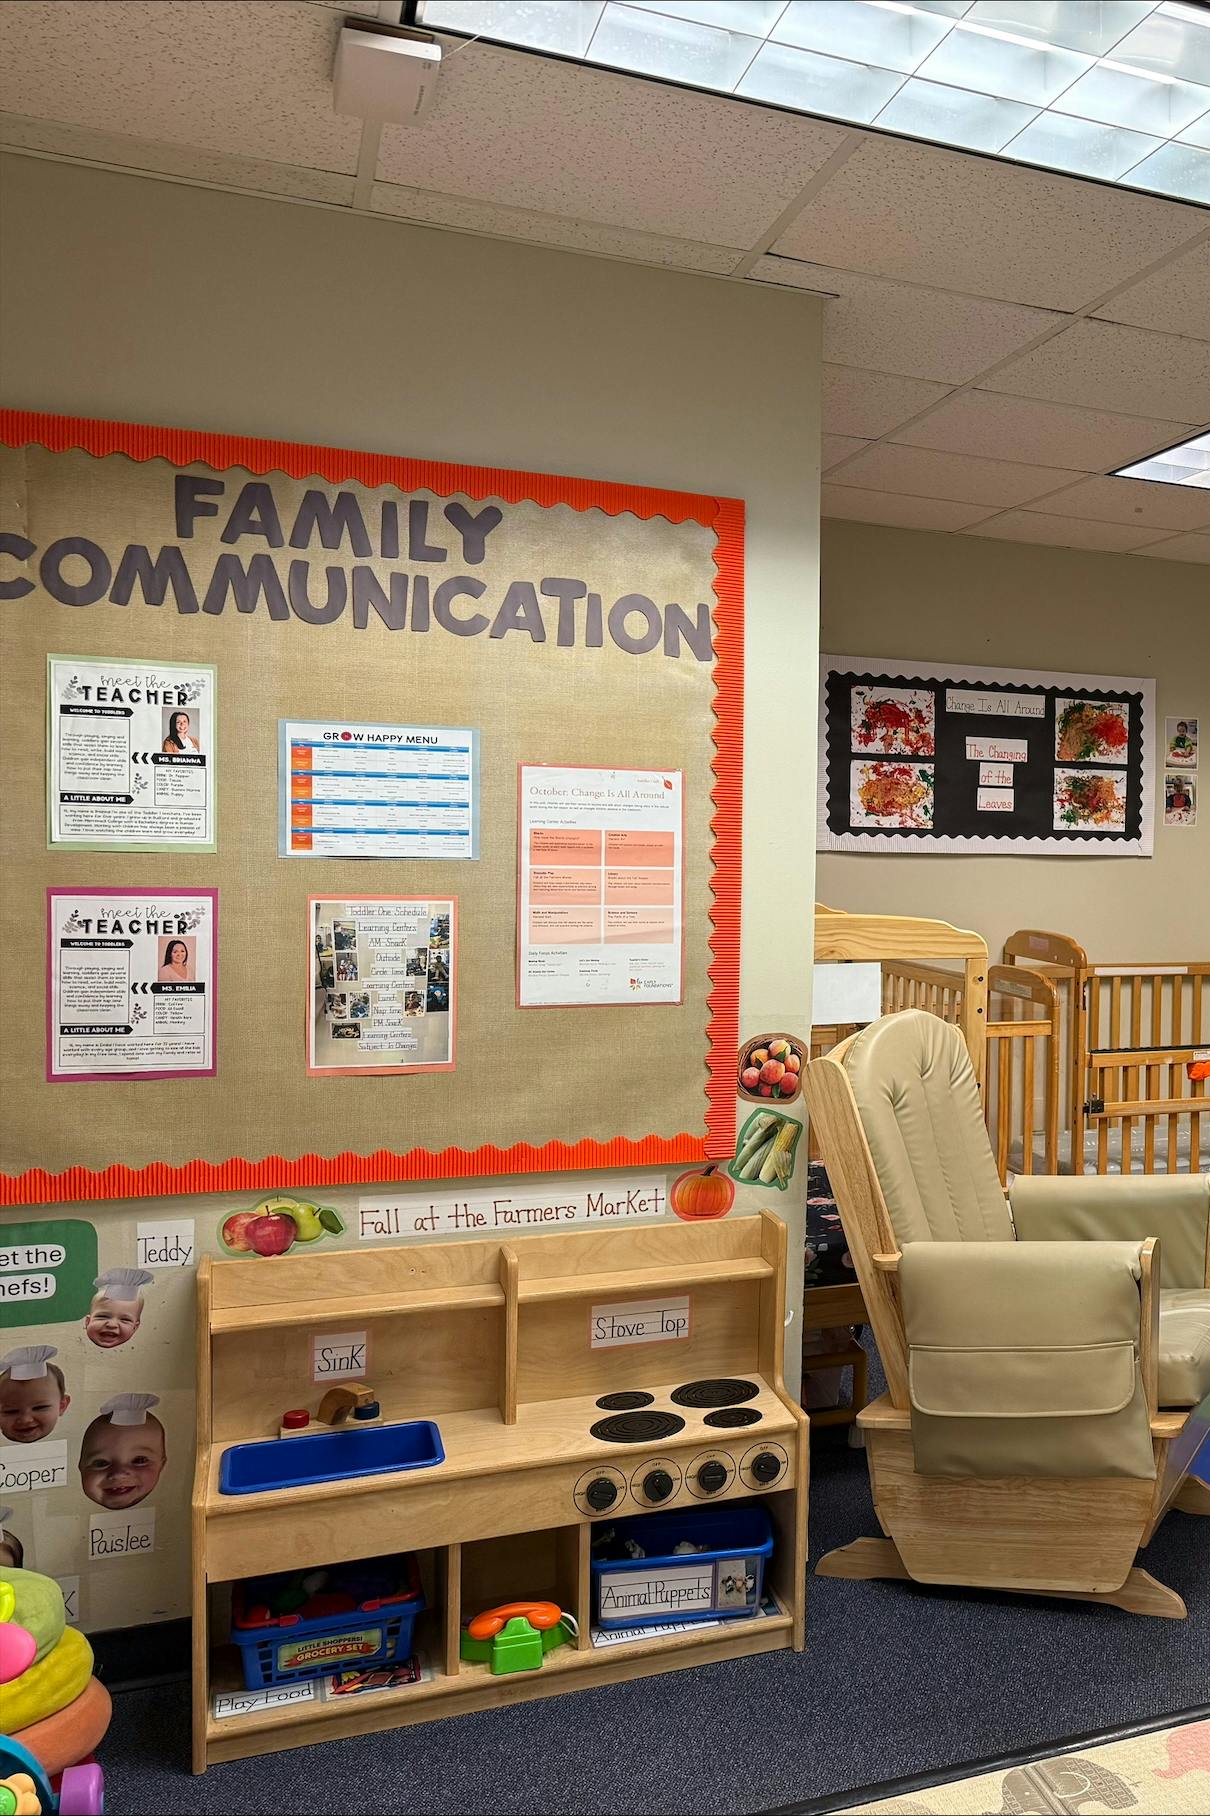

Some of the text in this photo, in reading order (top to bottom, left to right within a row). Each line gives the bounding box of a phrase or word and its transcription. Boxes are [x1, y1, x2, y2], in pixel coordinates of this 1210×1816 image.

[175, 475, 502, 564] FAMILY
[0, 532, 713, 661] COMMUNICATION
[100, 674, 171, 689] meet the
[82, 685, 188, 706] TEACHER
[946, 696, 1045, 716] Change Is All Around
[367, 733, 403, 744] HAPPY
[405, 734, 438, 745] MENU
[966, 744, 1027, 761] The Changing
[981, 770, 1012, 785] of the
[529, 786, 665, 800] October: Change Is All Around
[978, 794, 1012, 809] Leaves
[100, 905, 171, 920] meet the
[348, 905, 427, 918] Toddler One Schedule
[82, 918, 188, 935] TEACHER
[358, 922, 417, 935] Learning Centers
[376, 953, 401, 962] Outside
[371, 967, 404, 976] Circle Time
[362, 980, 414, 992] Learning Centers
[362, 1031, 388, 1040] Learning
[360, 1207, 400, 1236] Fall
[414, 1205, 440, 1231] at
[448, 1203, 487, 1229] the
[493, 1199, 576, 1226] Farmers
[0, 1248, 62, 1267] et the
[137, 1235, 192, 1266] Teddy
[0, 1277, 49, 1296] efs!
[595, 1310, 686, 1340] Stove Top
[90, 1525, 151, 1556] Paislee
[655, 1577, 711, 1609] Puppets
[296, 1643, 365, 1662] GROCERY SET
[297, 1636, 363, 1653] LITTLE SHOPPERS!
[218, 1683, 312, 1713] Play Food
